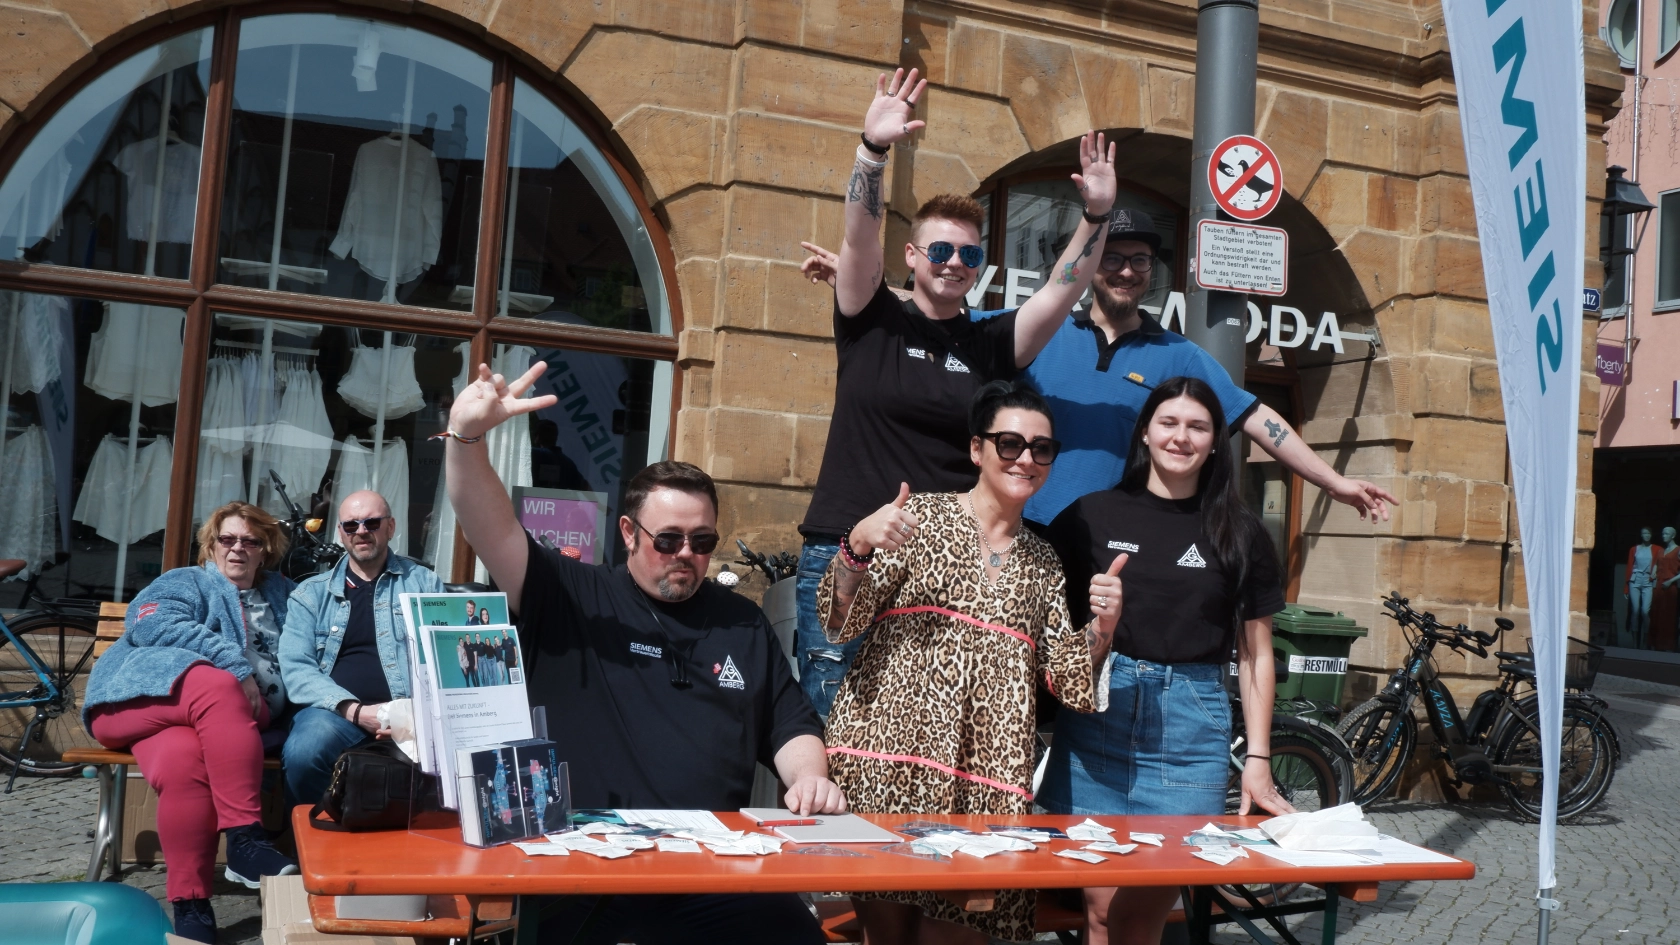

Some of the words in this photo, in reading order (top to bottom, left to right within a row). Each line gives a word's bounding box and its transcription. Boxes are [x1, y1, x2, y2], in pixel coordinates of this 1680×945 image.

[1204, 226, 1224, 234] Tauben
[1226, 229, 1244, 237] füttern
[1255, 233, 1282, 241] gesamten
[1214, 235, 1245, 244] Stadtgebiet
[1223, 246, 1244, 254] Verstoß
[1204, 251, 1258, 263] Ordnungswidrigkeit
[1251, 264, 1272, 272] werden.
[1231, 271, 1251, 279] Füttern
[1234, 278, 1268, 288] unterlassen!
[523, 500, 555, 516] WIR
[1108, 540, 1139, 550] SIEMENS
[630, 642, 662, 654] SIEMENS
[1304, 658, 1348, 673] RESTMÜLL
[719, 681, 745, 690] AMBERG
